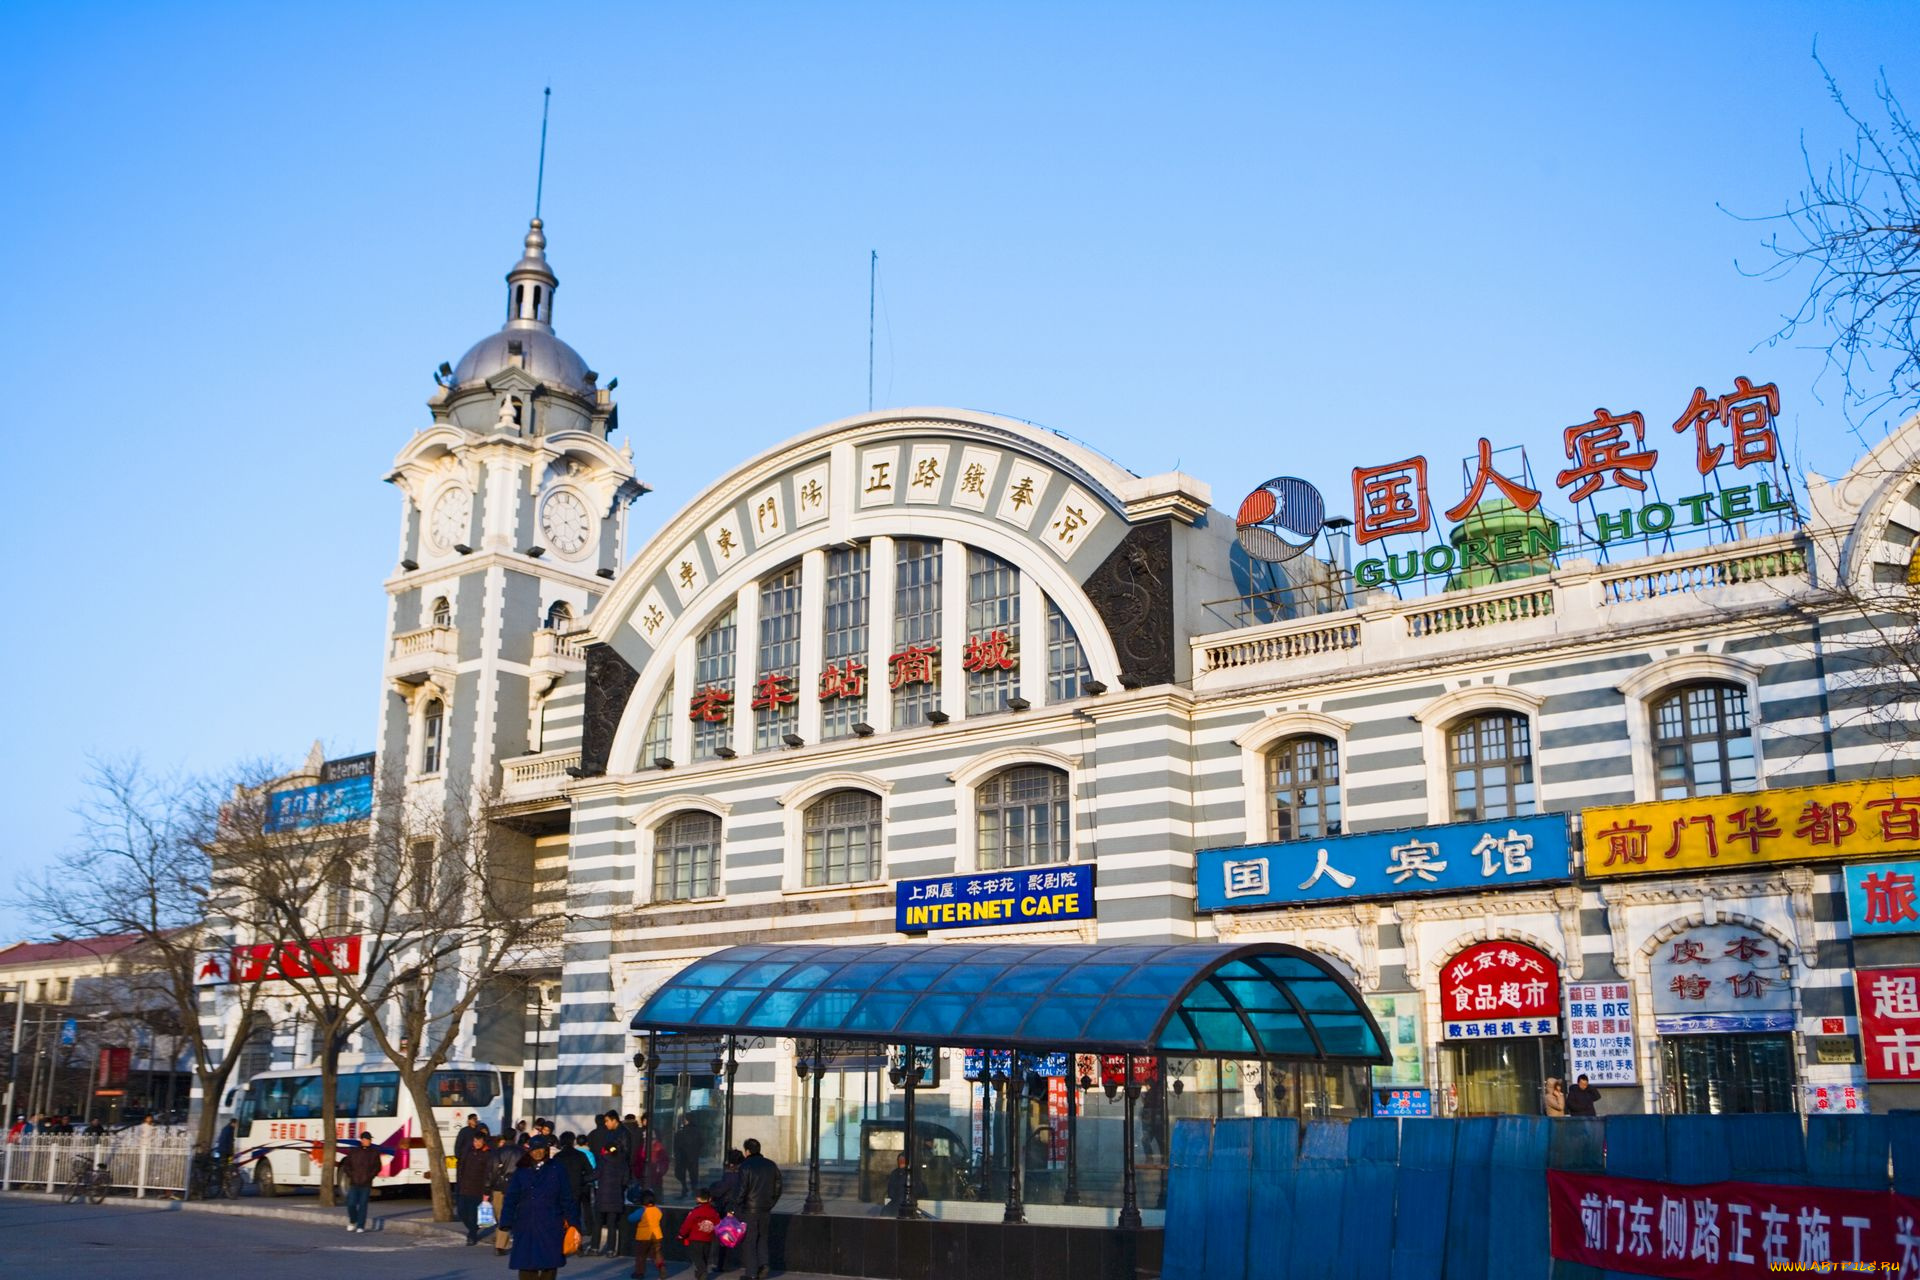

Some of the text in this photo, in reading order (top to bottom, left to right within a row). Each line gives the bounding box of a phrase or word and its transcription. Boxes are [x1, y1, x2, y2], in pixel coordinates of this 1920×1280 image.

[1352, 376, 1780, 545] 国人宾馆
[1354, 481, 1790, 587] GUOREN HOTEL
[689, 629, 1017, 722] 老车站商城
[1223, 829, 1534, 899] 国人宾馆
[908, 871, 1077, 900] 上网屋 茶书苑 影剧院
[1861, 871, 1919, 925] 旅
[906, 893, 1079, 925] INTERNET CAFE
[1451, 949, 1545, 985] 北京特产
[1450, 977, 1549, 1012] 食品超市
[1571, 1002, 1630, 1017] 服装 内衣
[1448, 1019, 1552, 1037] 数码相机专卖
